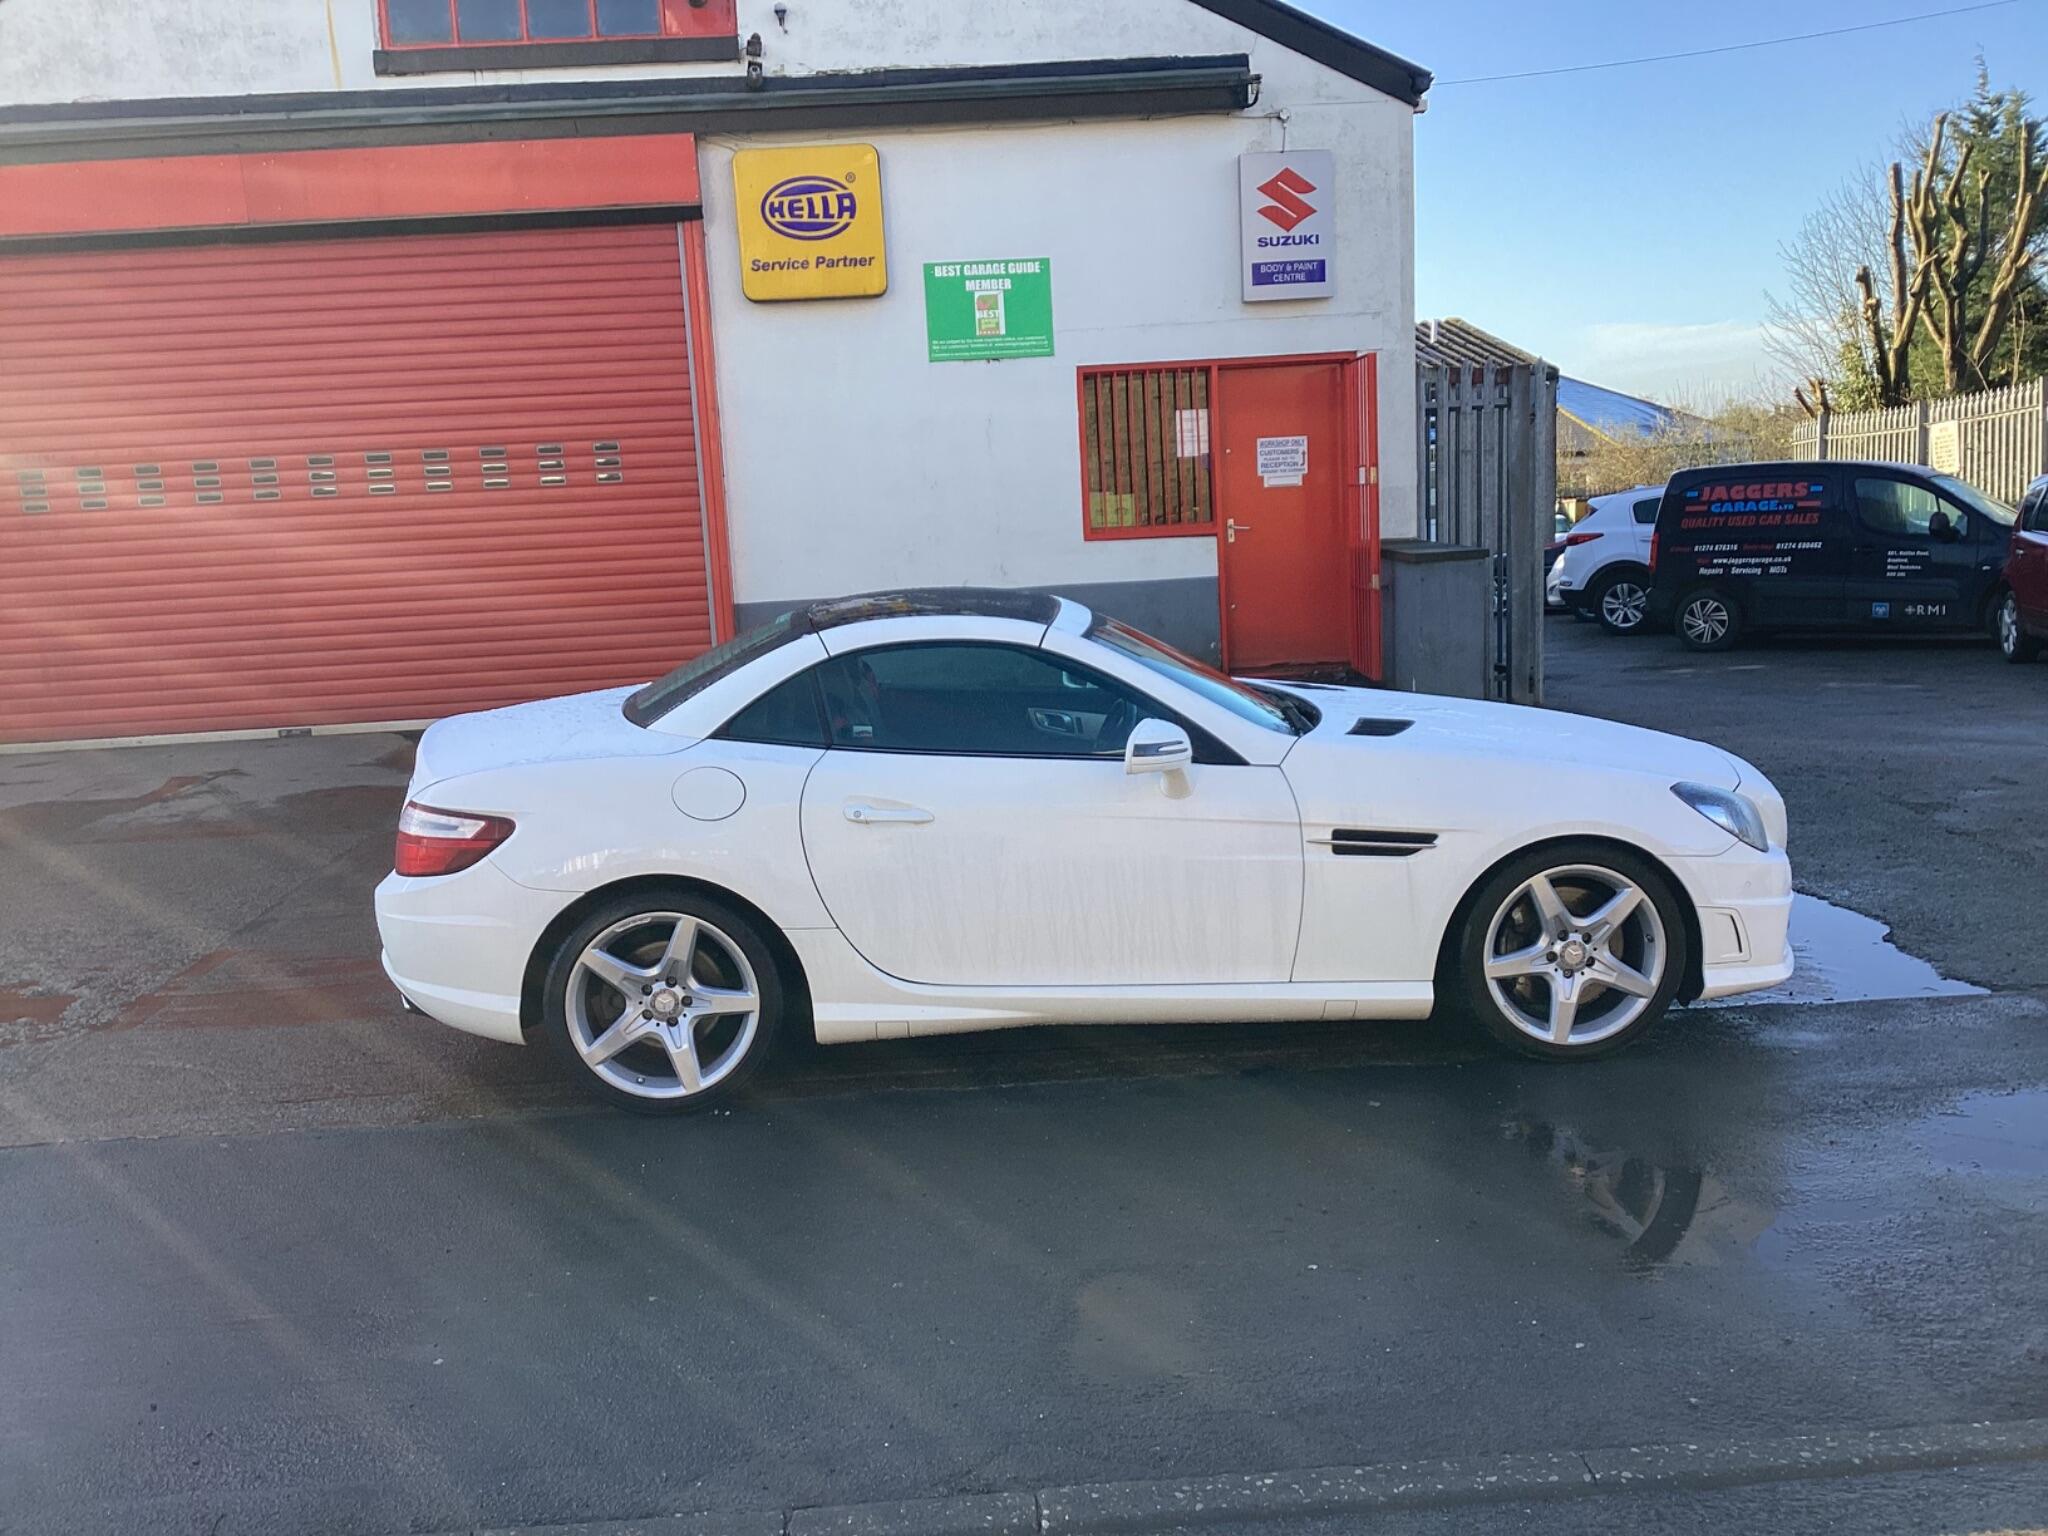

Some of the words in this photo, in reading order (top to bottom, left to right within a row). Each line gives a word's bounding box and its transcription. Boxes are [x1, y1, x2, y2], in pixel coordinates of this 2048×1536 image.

[768, 192, 857, 219] HELLA
[1257, 234, 1320, 248] SUZUKI
[751, 257, 809, 272] Service
[815, 255, 875, 269] Partner
[934, 264, 961, 277] BEST
[963, 262, 1006, 276] GARAGE
[1008, 261, 1041, 274] GUIDE
[1260, 263, 1285, 273] BODY
[1286, 263, 1293, 272] &
[1294, 261, 1318, 272] PAINT
[1273, 271, 1306, 282] CENTRE
[965, 278, 1012, 291] MEMBER
[1261, 461, 1299, 469] RECEPTION
[1701, 482, 1808, 501] JAGGERS
[1711, 500, 1777, 513] GARAGE
[1681, 515, 1725, 529] QUALITY
[1727, 515, 1756, 527] USED
[1760, 514, 1782, 525] CAR
[1785, 513, 1819, 525] SALES
[1699, 567, 1724, 575] Repairs
[1731, 566, 1762, 575] Servicing
[1916, 604, 1946, 616] RMI
